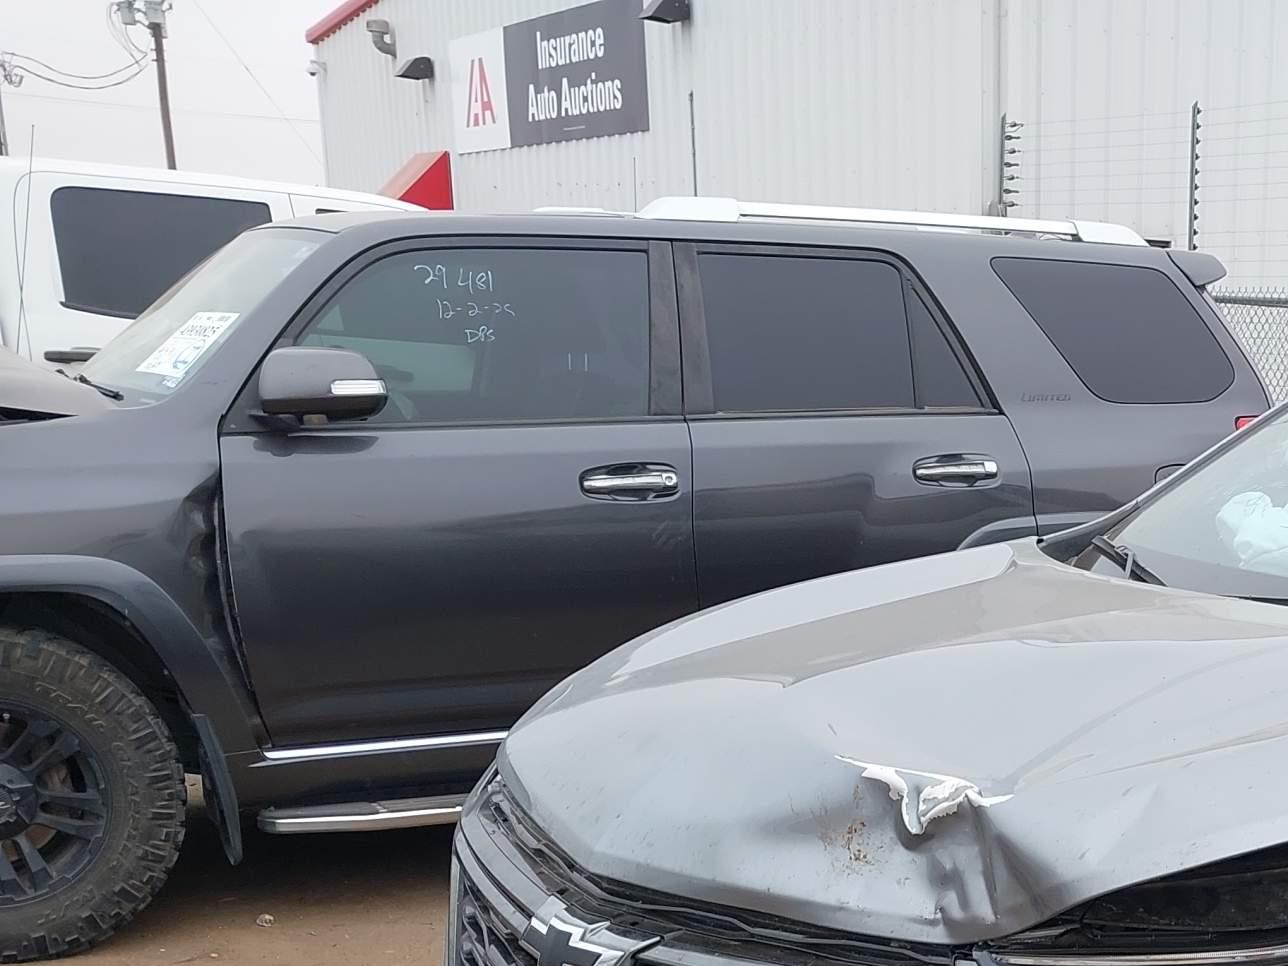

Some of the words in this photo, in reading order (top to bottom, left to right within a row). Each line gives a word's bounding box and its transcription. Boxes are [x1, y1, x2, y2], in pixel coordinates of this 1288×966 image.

[536, 26, 605, 70] Insurance
[528, 83, 559, 122] Auto
[561, 72, 622, 117] Auctions
